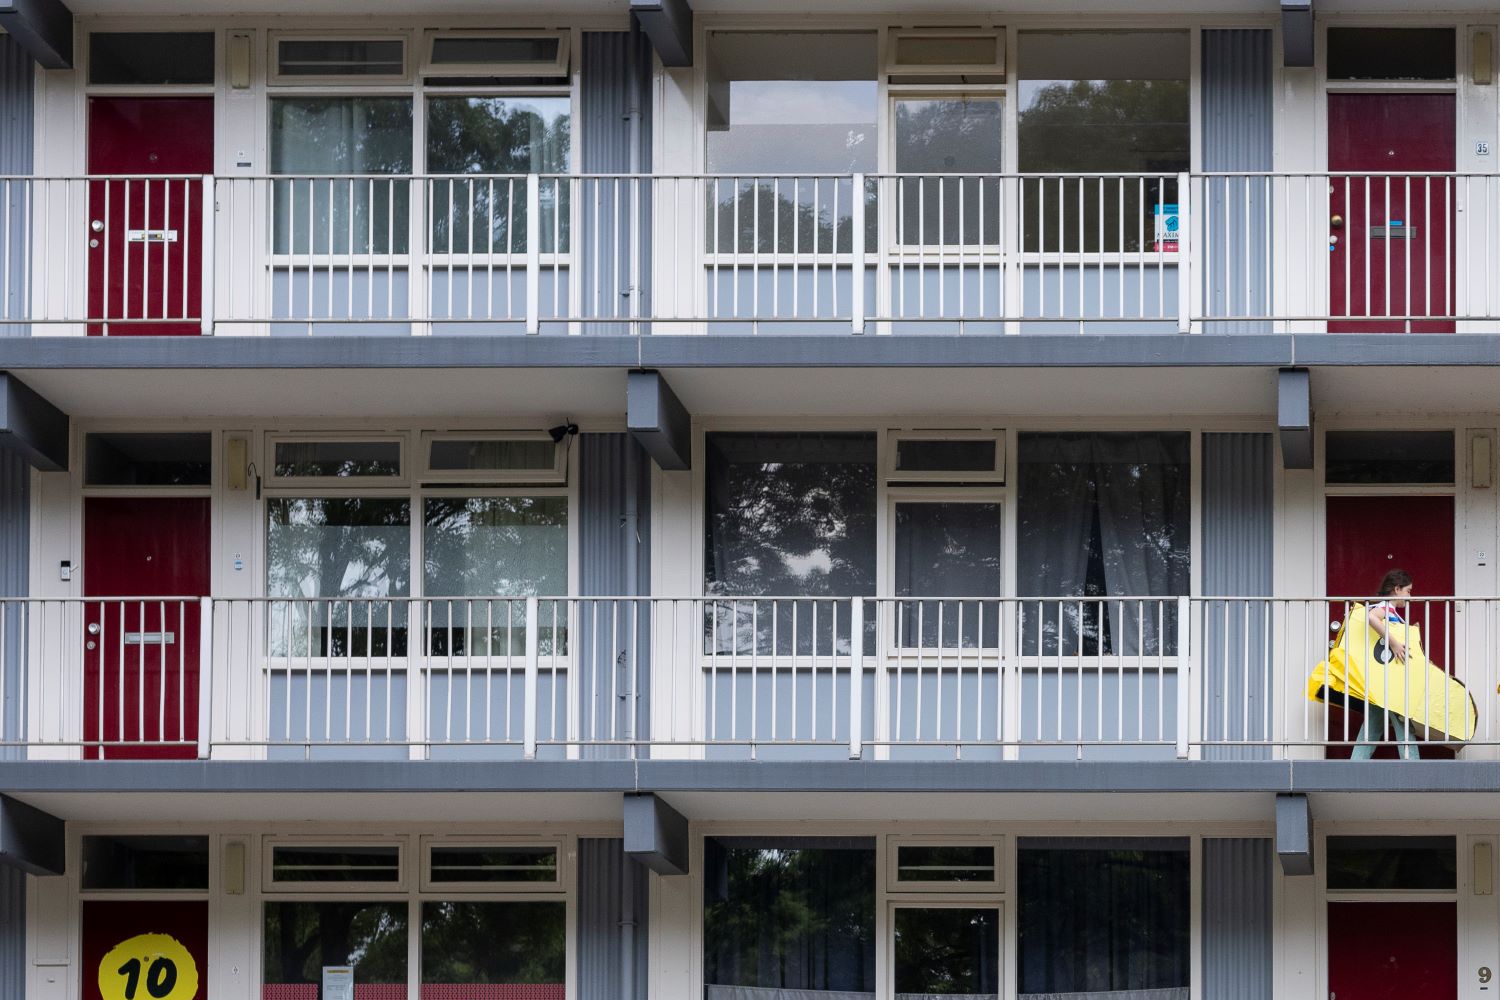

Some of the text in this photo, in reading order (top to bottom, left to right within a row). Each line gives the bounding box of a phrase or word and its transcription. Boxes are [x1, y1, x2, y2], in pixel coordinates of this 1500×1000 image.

[1477, 143, 1488, 153] 35
[117, 956, 178, 1000] 10
[1478, 966, 1492, 984] 9
